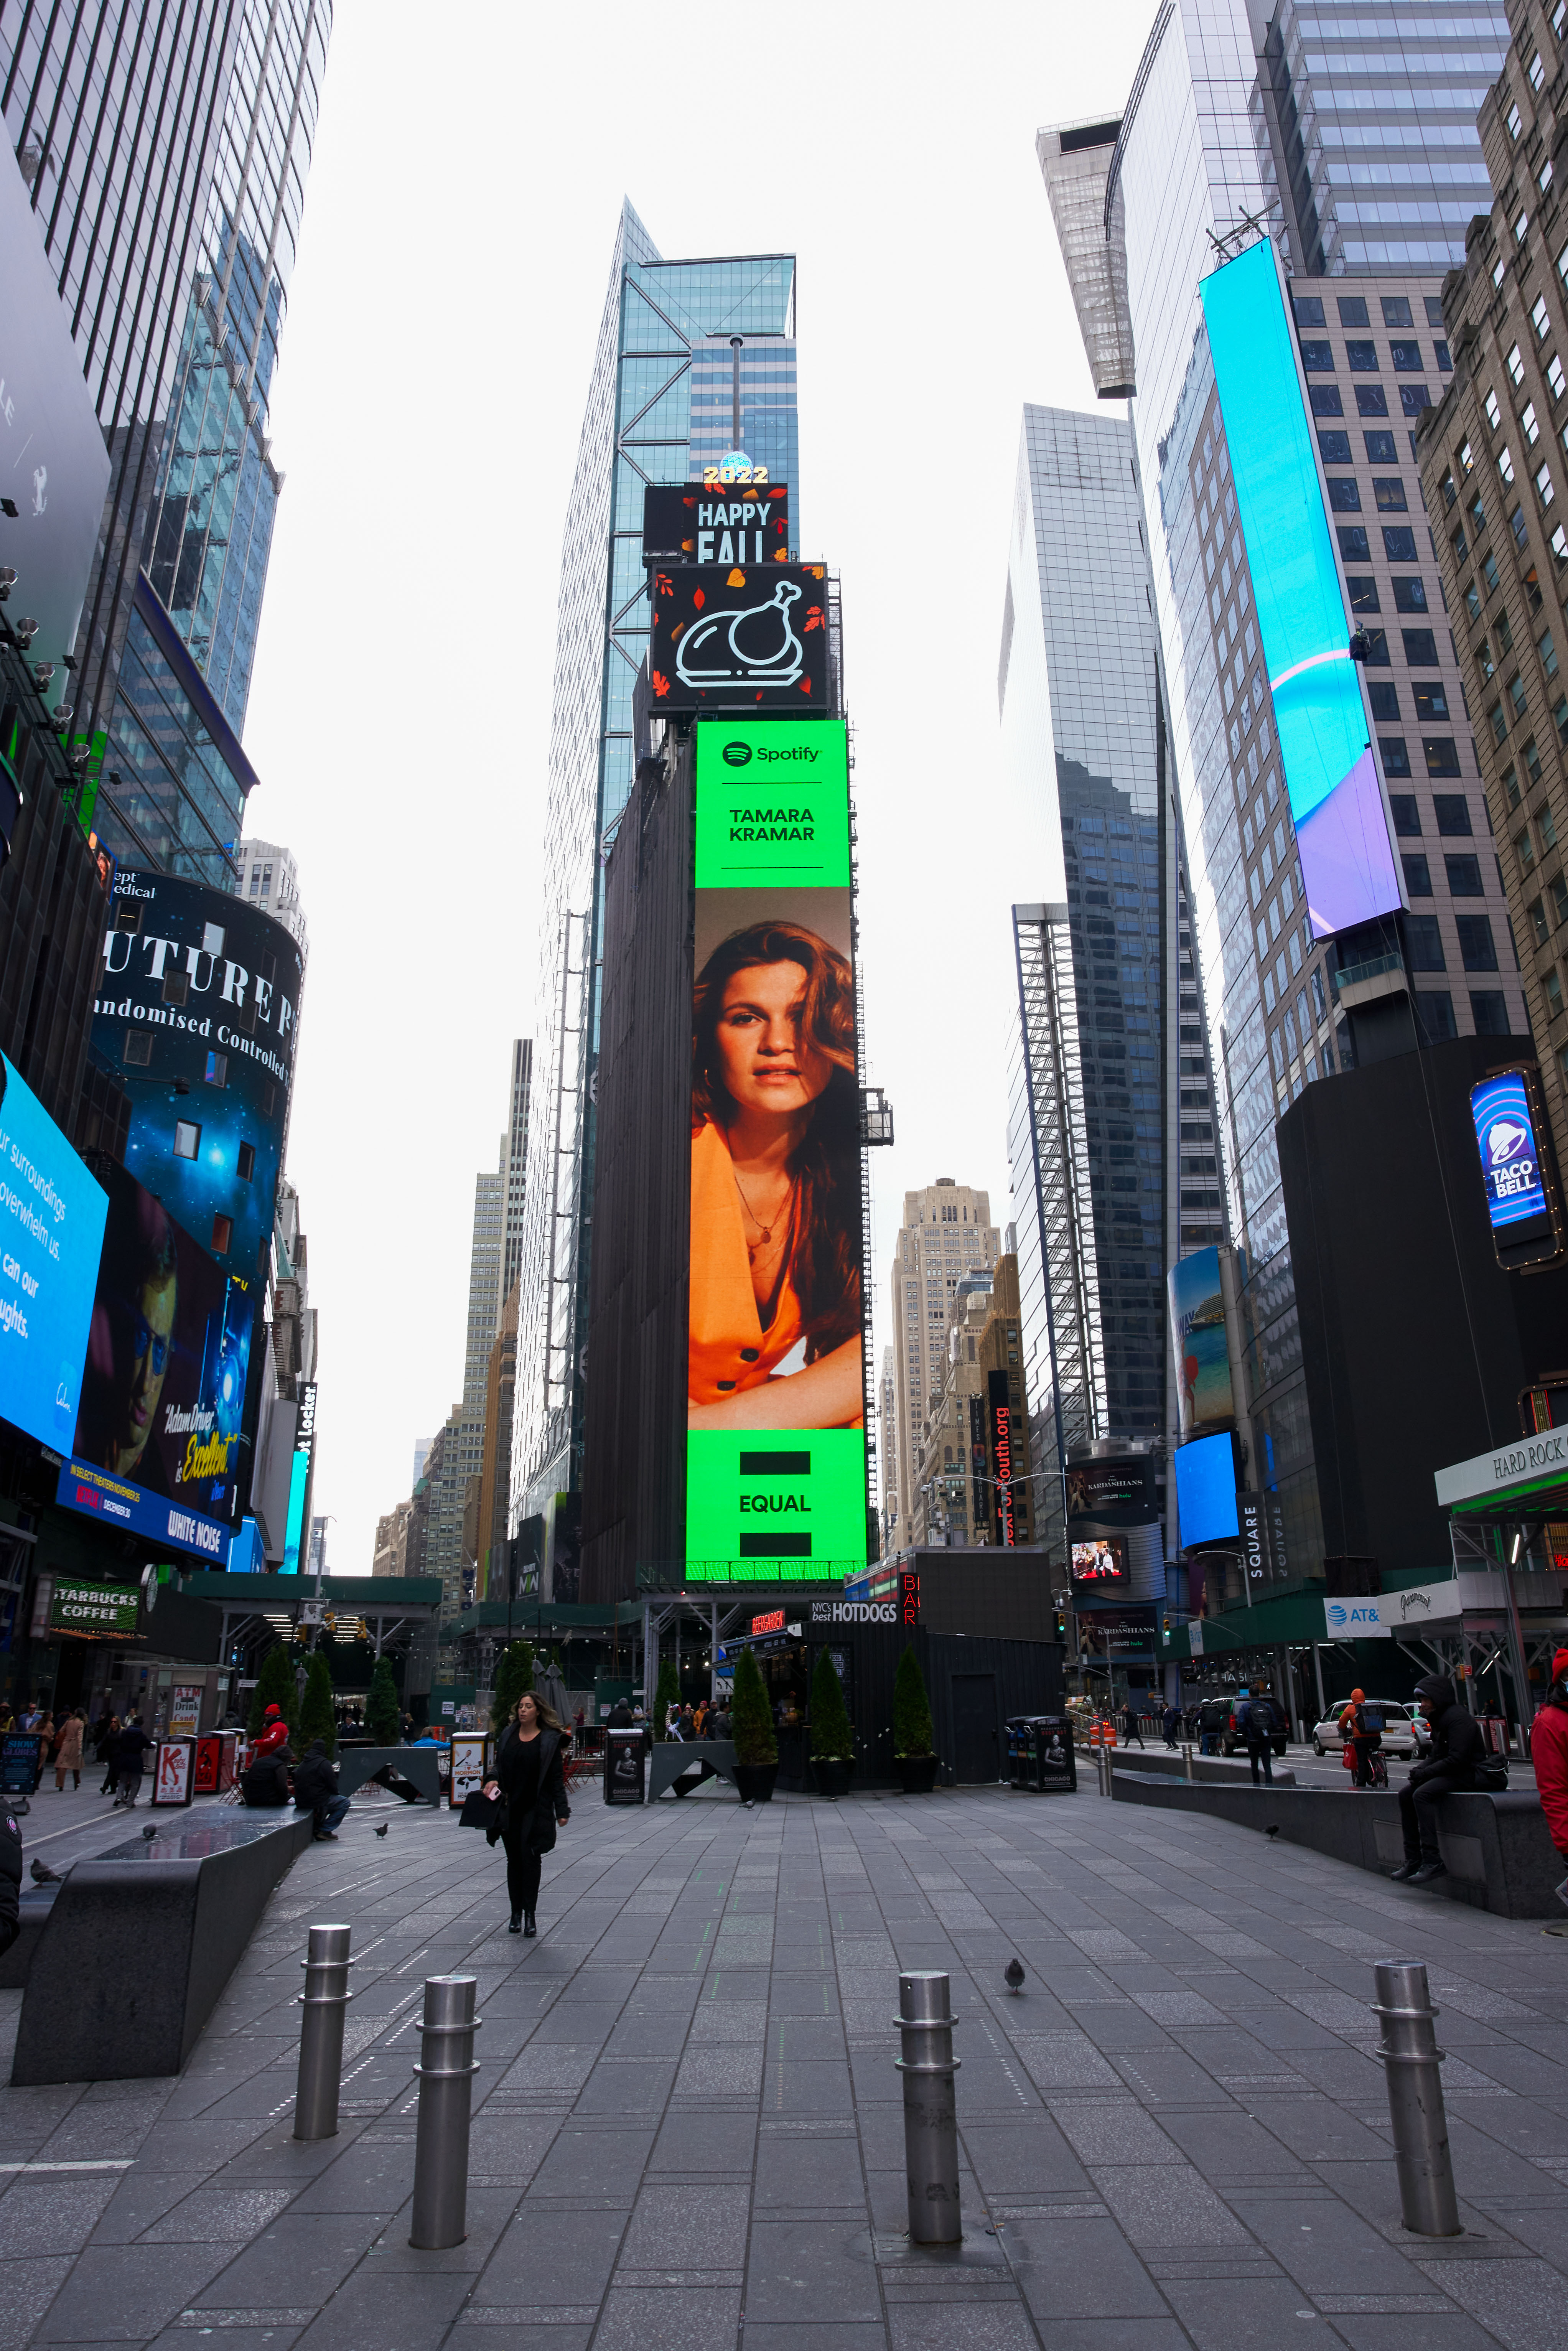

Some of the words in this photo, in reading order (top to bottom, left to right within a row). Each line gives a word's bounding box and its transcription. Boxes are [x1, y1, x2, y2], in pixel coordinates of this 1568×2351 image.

[703, 467, 768, 483] 2022
[698, 503, 771, 526] HAPPY
[757, 747, 819, 763] Spotify
[730, 809, 814, 823] TAMARA
[730, 827, 814, 841] KRAMAR
[114, 872, 137, 885] ept
[114, 883, 155, 899] edical
[103, 931, 273, 1023] UTURE
[94, 998, 211, 1037] andomised
[10, 1144, 66, 1222] surroundings
[1490, 1160, 1533, 1185] TACO
[1496, 1175, 1535, 1199] BELL
[0, 1182, 48, 1247] overwhelm
[49, 1236, 59, 1261] us.
[3, 1253, 20, 1283] can
[21, 1271, 39, 1298] our
[0, 1298, 28, 1339] ughts.
[1493, 1450, 1526, 1478] HARD
[1528, 1436, 1566, 1467] ROCK
[1088, 1479, 1143, 1490] KARDASHIANS
[740, 1495, 812, 1512] EQUAL
[168, 1510, 196, 1544] WHITE
[195, 1521, 221, 1553] NOISE
[1244, 1507, 1262, 1578] SQUARE
[904, 1575, 916, 1624] BAR
[1401, 1592, 1431, 1620] Paramount
[61, 1605, 118, 1620] COFFEE
[752, 1610, 783, 1634] BEERGARDEN
[812, 1612, 832, 1621] best
[833, 1603, 897, 1622] HOTDOGS
[1351, 1608, 1380, 1622] AT&
[1098, 1628, 1155, 1636] KARDASHIANS
[176, 1688, 201, 1697] ATM
[175, 1702, 199, 1711] Drink
